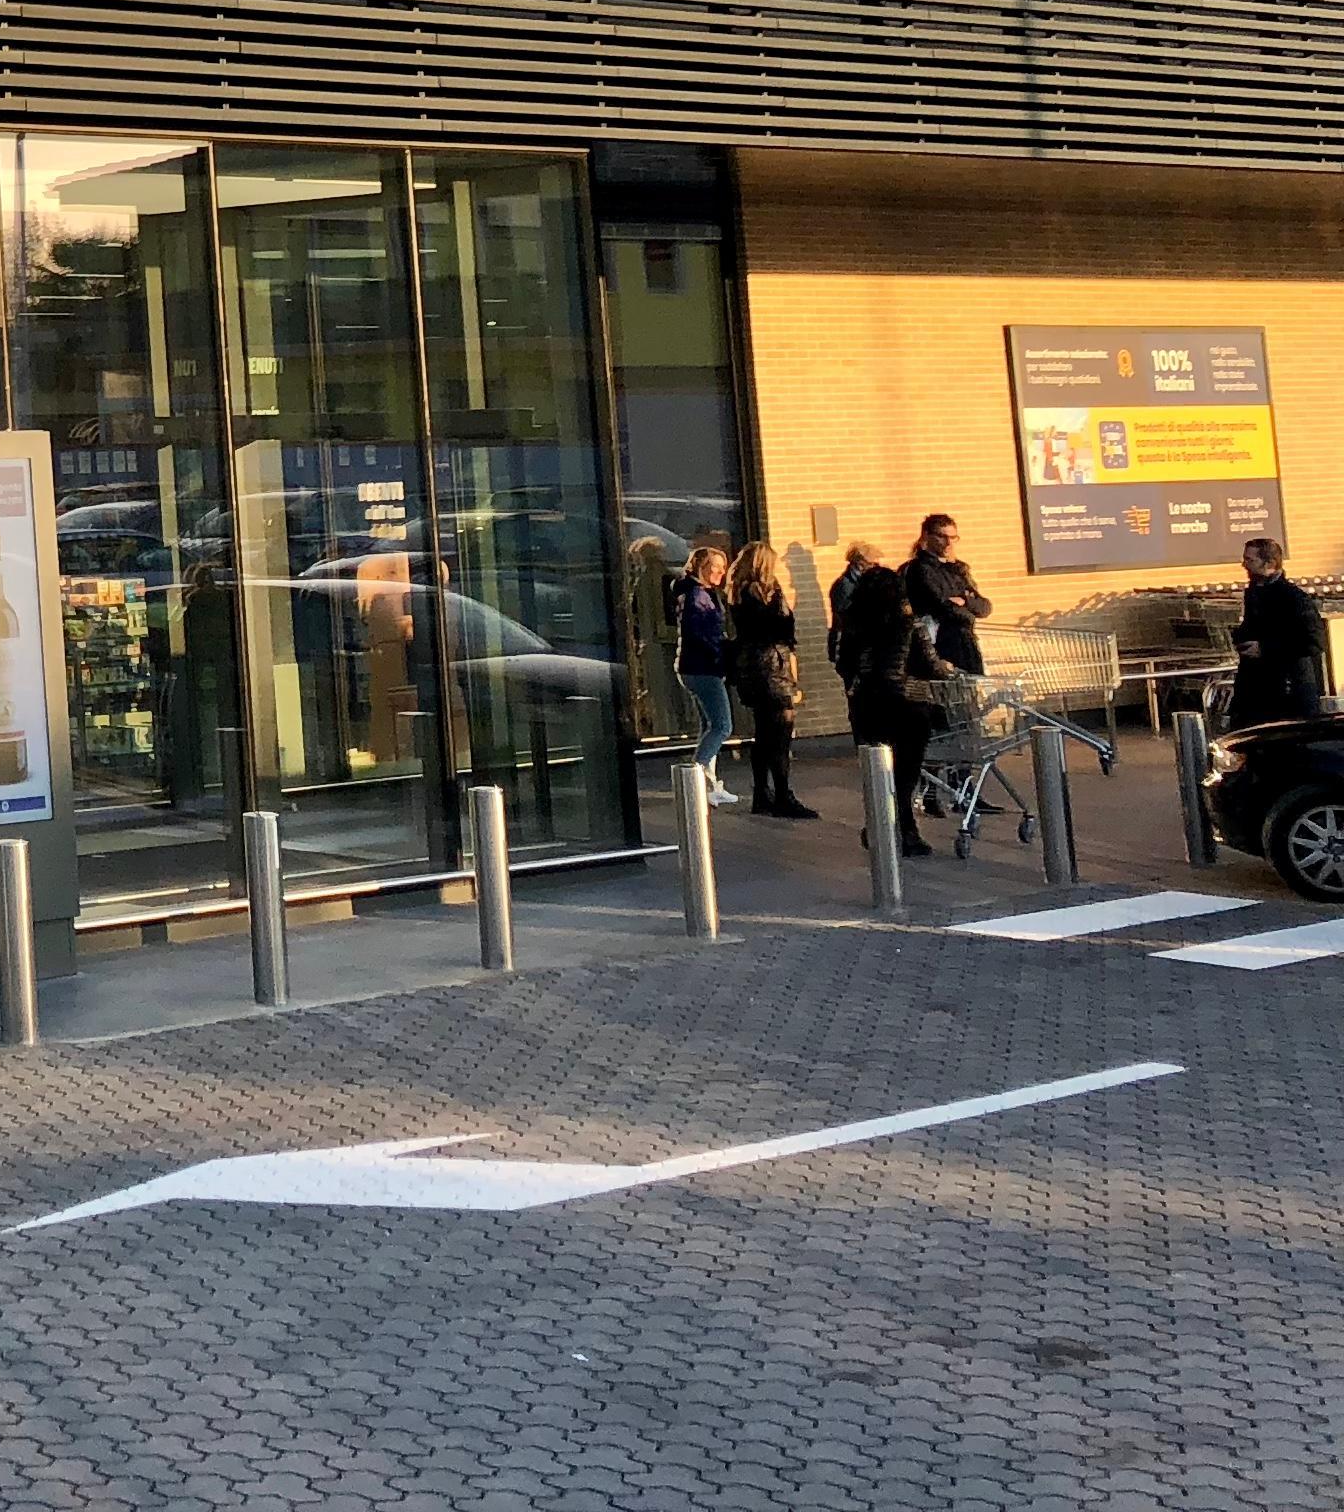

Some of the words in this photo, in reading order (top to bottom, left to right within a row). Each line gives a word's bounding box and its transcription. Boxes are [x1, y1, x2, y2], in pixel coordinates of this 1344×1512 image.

[1151, 349, 1193, 371] 100%
[1169, 502, 1180, 515] Le
[1181, 501, 1211, 515] nostre
[1171, 520, 1208, 533] marche
